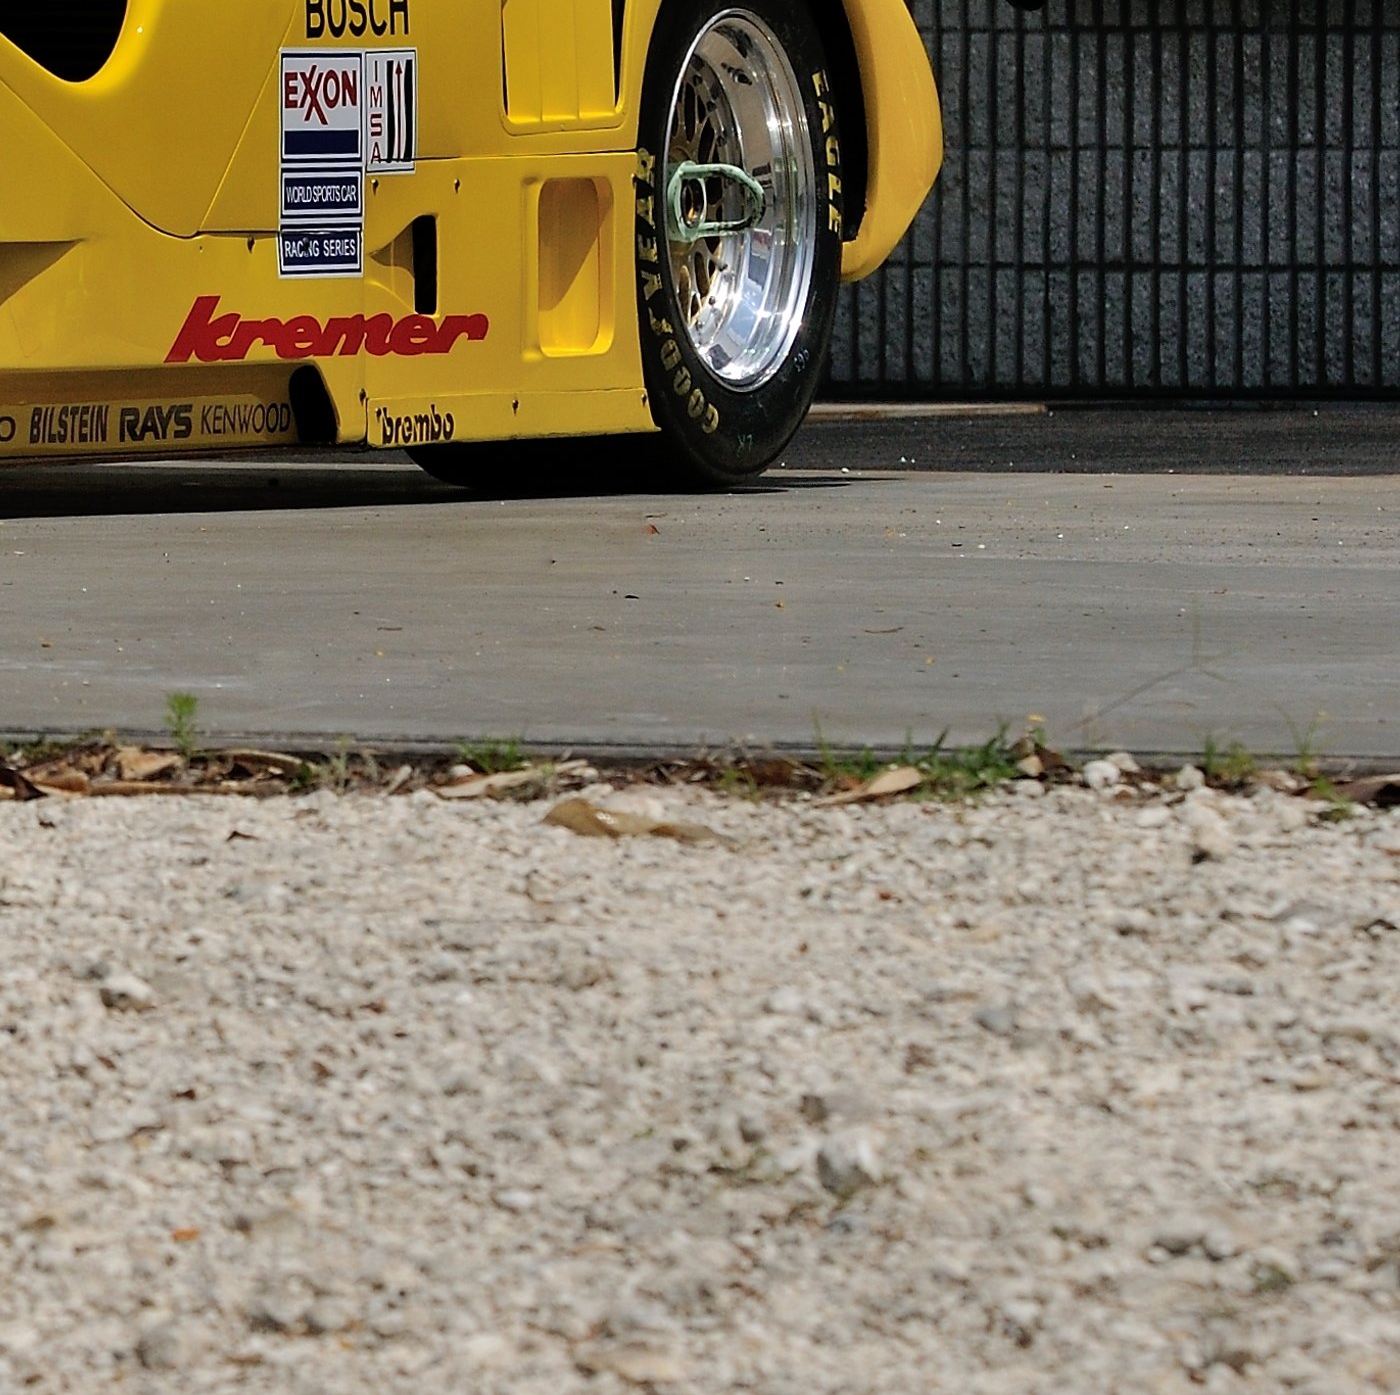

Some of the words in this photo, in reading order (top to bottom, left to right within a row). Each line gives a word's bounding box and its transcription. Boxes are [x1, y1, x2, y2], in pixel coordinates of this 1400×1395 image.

[284, 64, 358, 126] EXXON
[369, 59, 384, 165] IMSA
[811, 69, 845, 242] EAGLE
[285, 185, 313, 204] WORLD
[312, 184, 341, 203] SPORTS
[341, 184, 357, 202] CAR
[284, 239, 320, 258] RACNG
[323, 238, 357, 257] SERIES
[163, 295, 489, 364] kremer
[29, 406, 109, 445] BILSTEIN
[119, 403, 194, 442] RAYS
[200, 402, 291, 435] KENWOOD
[376, 403, 455, 445] brembo
